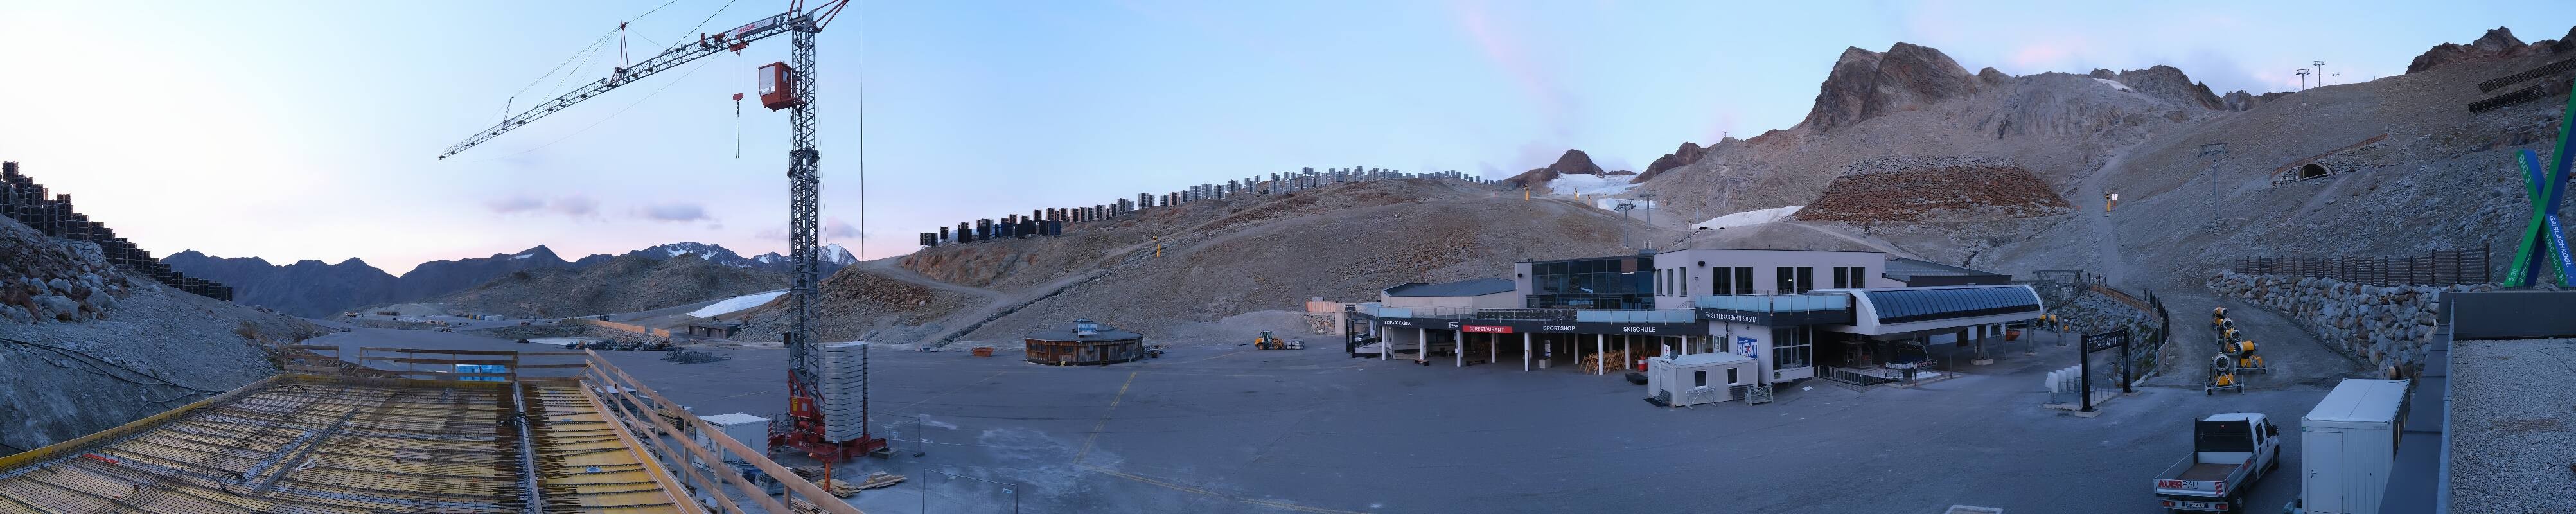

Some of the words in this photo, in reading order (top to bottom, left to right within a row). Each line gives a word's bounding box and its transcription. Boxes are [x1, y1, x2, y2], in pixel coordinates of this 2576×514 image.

[2519, 154, 2528, 175] BIG
[2526, 175, 2531, 184] 3
[2158, 479, 2199, 490] AUERBAU
